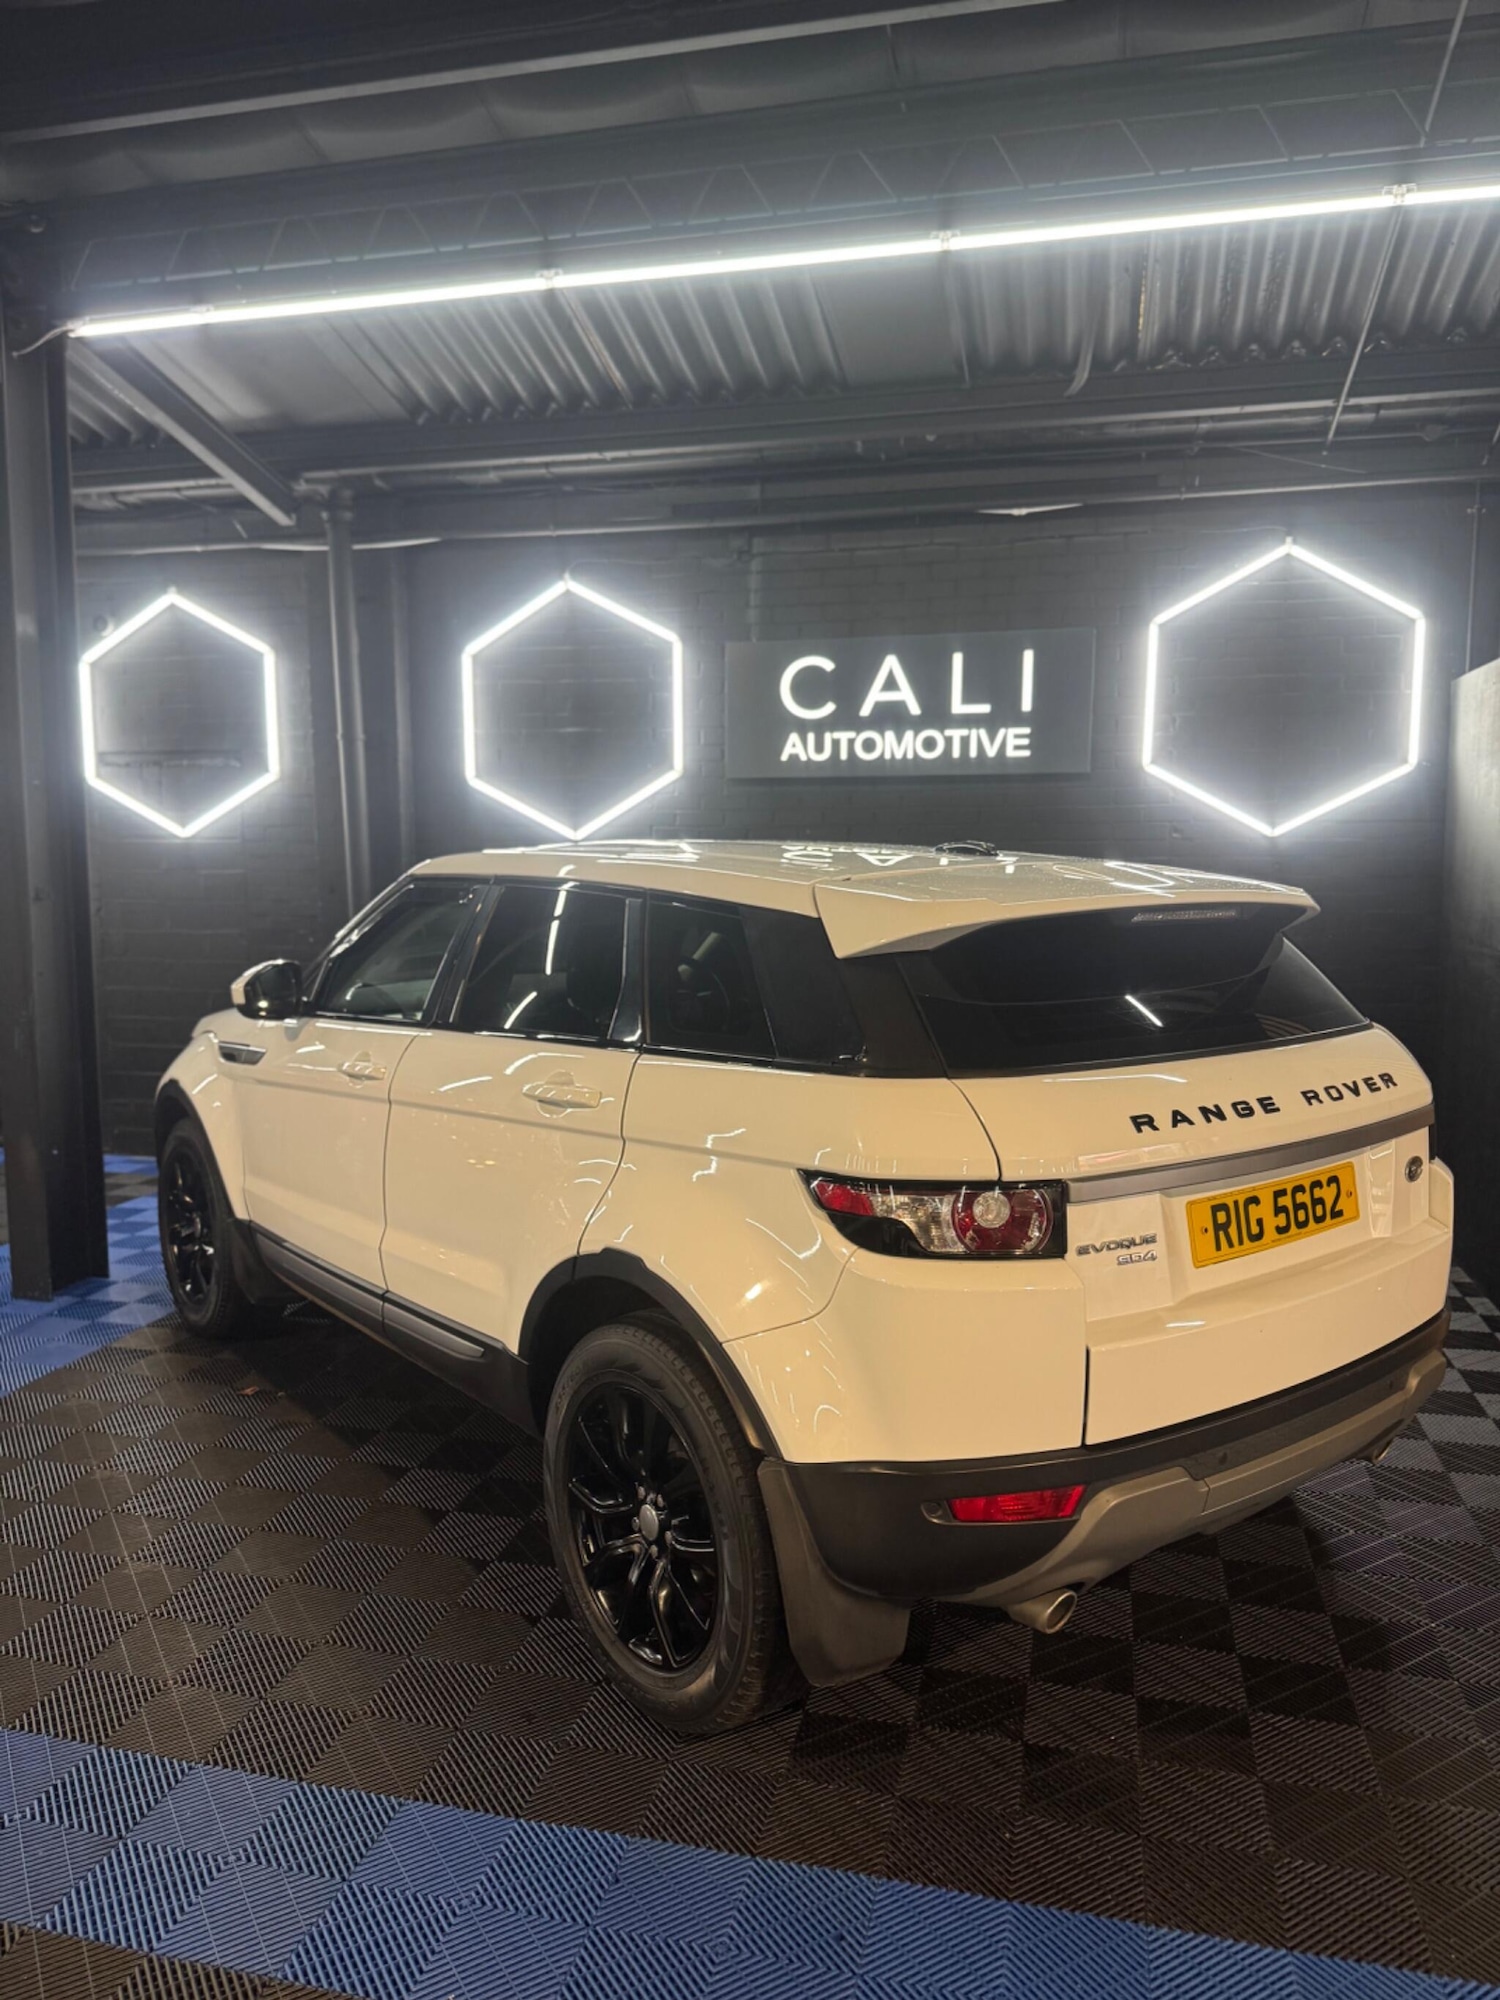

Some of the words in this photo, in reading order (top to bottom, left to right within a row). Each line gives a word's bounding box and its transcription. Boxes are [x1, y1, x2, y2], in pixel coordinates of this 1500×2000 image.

[779, 649, 1034, 719] CALI
[780, 727, 1031, 761] AUTOMOTIVE
[1130, 1096, 1281, 1133] RANGE
[1300, 1072, 1398, 1106] ROVER
[1210, 1196, 1265, 1251] RIG
[1273, 1175, 1344, 1235] 5662
[1076, 1233, 1157, 1256] EVOQUE
